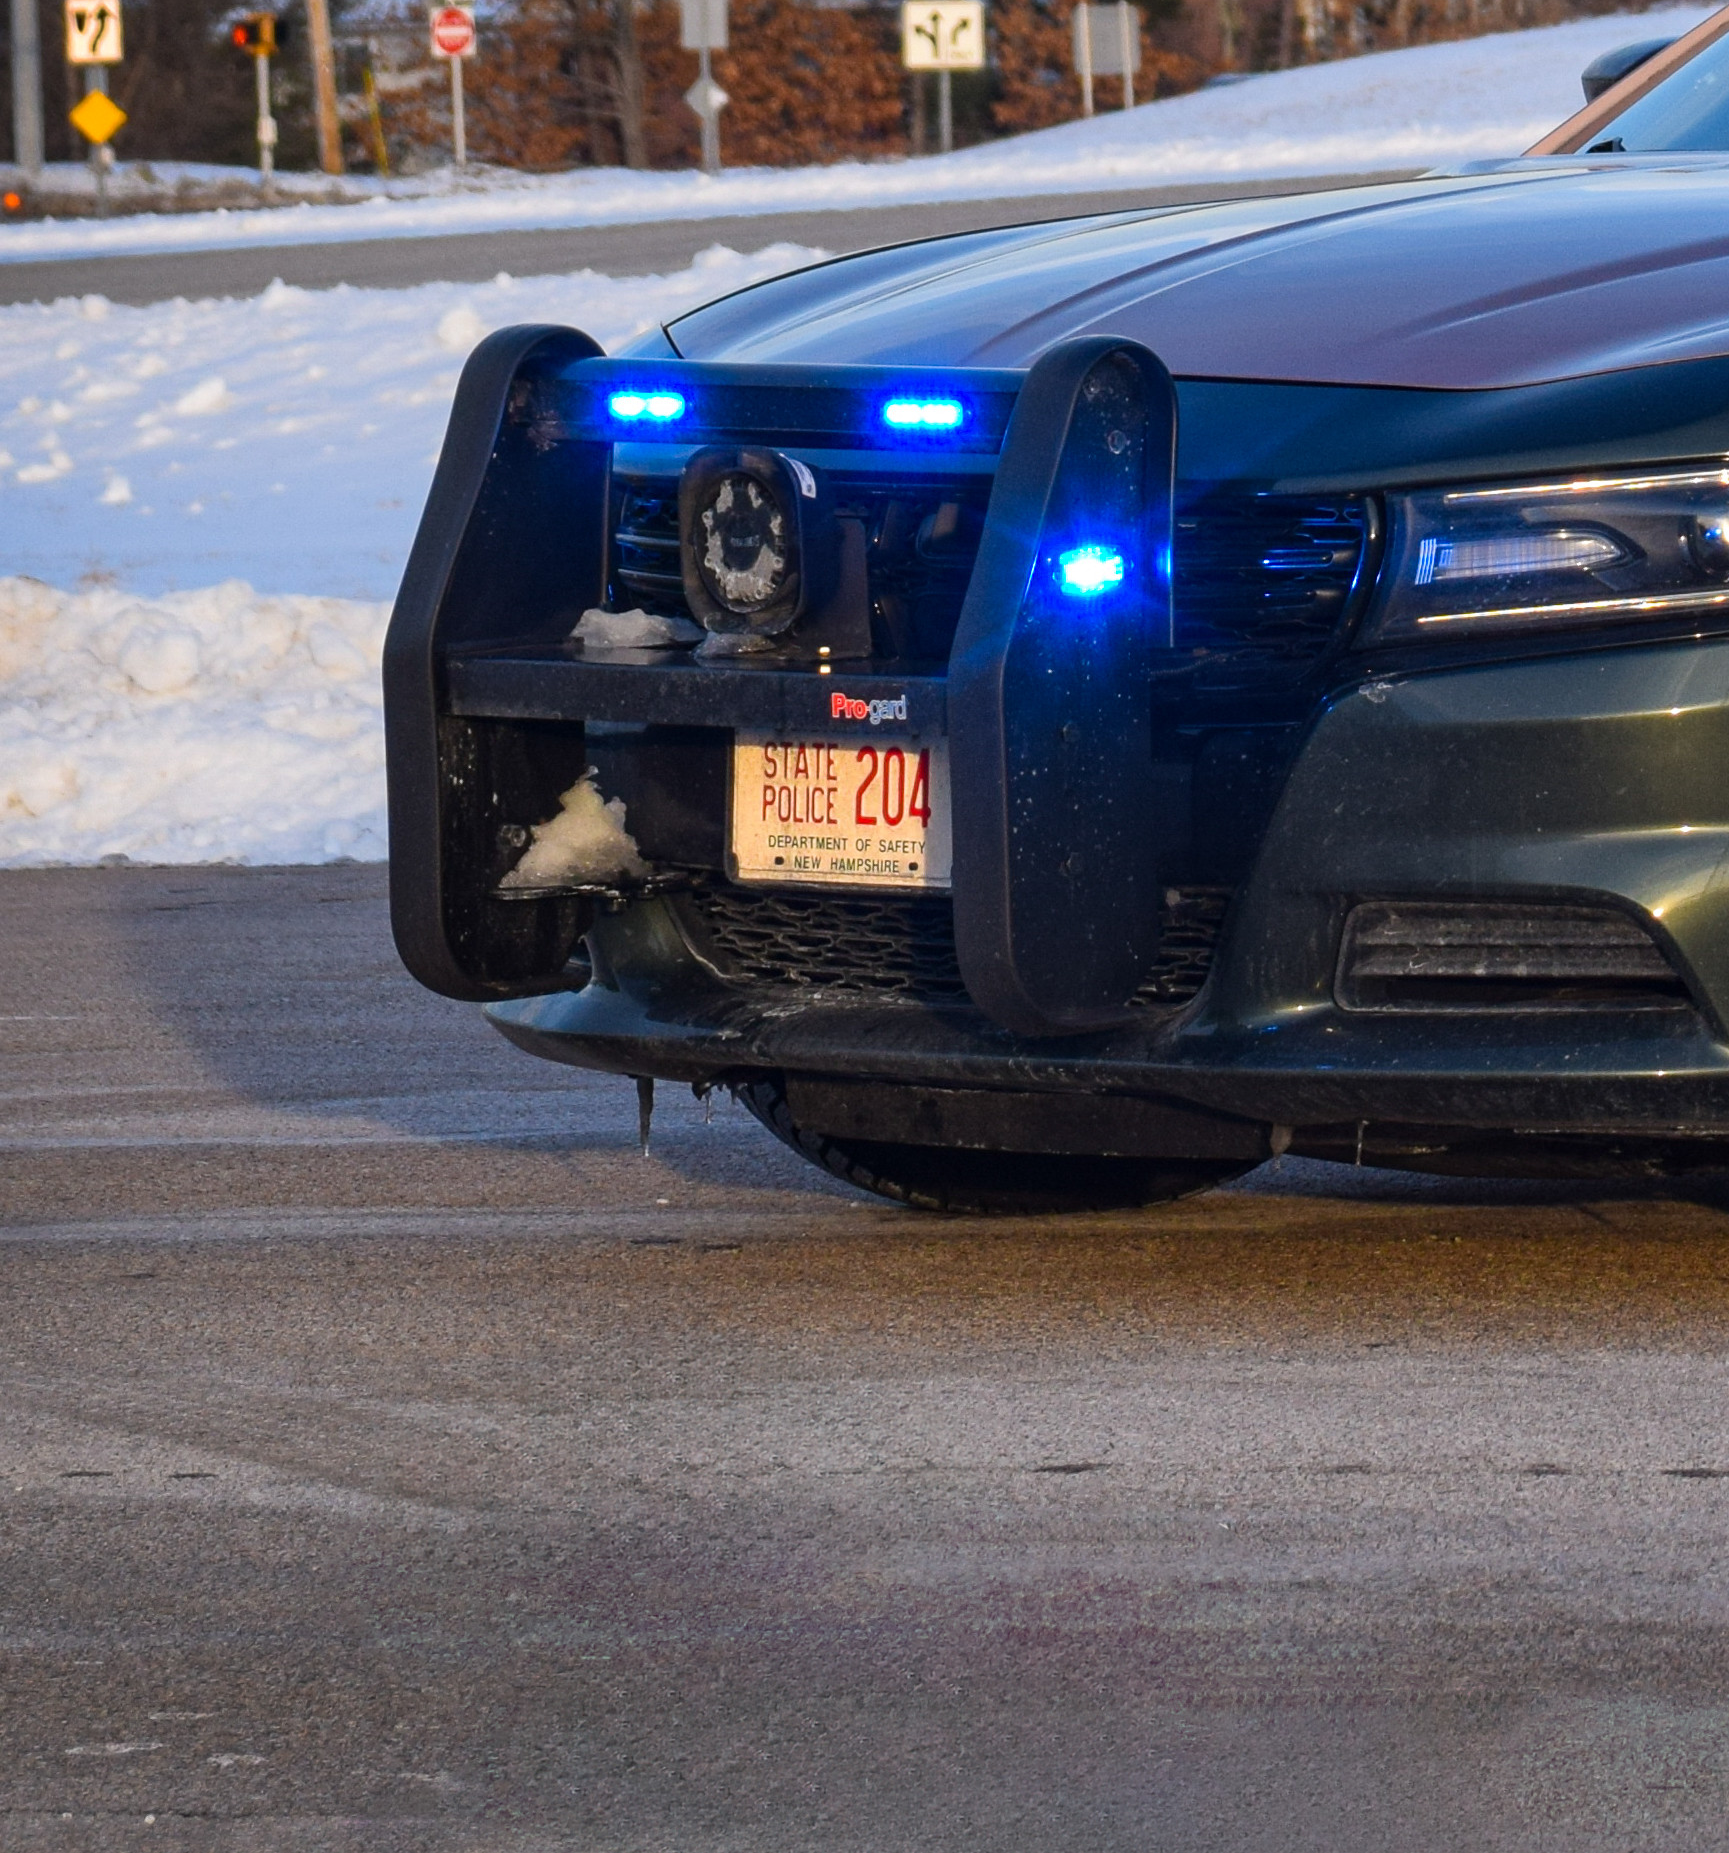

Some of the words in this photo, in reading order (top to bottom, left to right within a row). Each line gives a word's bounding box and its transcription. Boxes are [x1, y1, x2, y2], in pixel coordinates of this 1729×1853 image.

[763, 741, 838, 781] STATE
[761, 784, 838, 825] POLICE
[855, 745, 932, 828] 204
[768, 835, 848, 851] DEPARTMENT
[855, 838, 872, 852] OF
[878, 839, 926, 854] SAFETY
[794, 856, 822, 867] NEW
[830, 857, 900, 873] HAMPSHIRE
